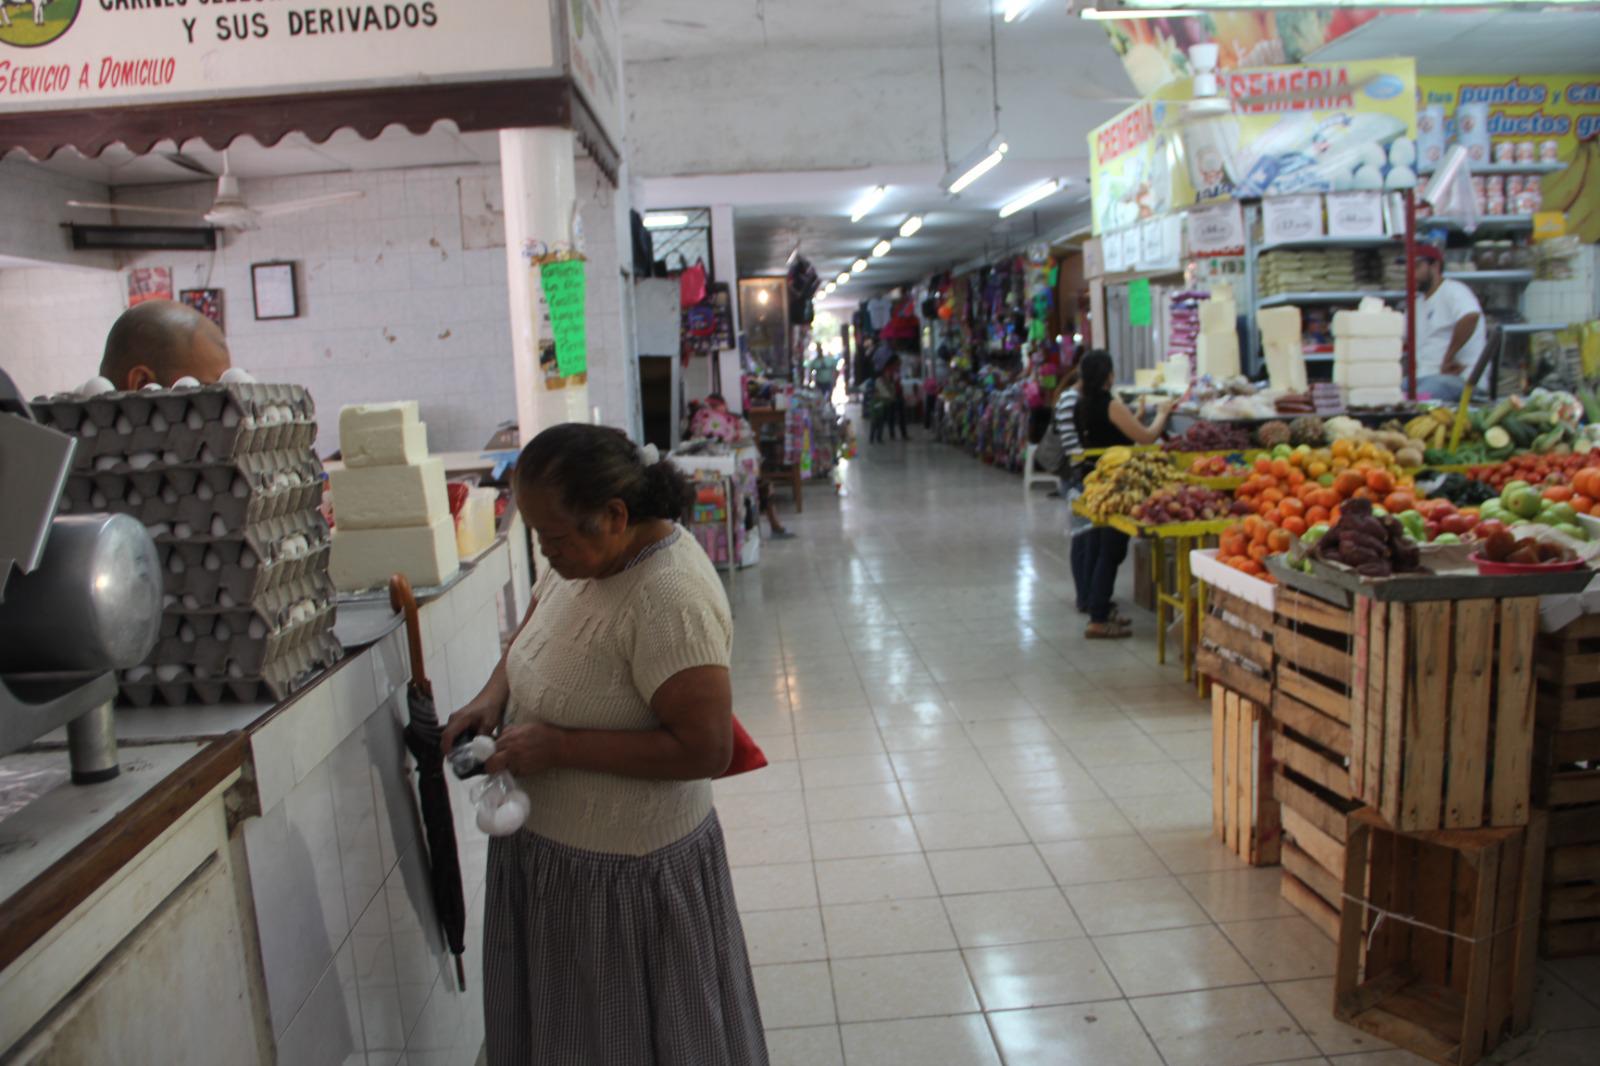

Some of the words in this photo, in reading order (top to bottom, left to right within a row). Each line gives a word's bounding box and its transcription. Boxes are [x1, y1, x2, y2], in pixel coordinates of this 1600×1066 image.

[182, 17, 196, 43] Y
[216, 13, 269, 41] SUS
[288, 1, 438, 36] DERIVADOS
[79, 62, 89, 90] A
